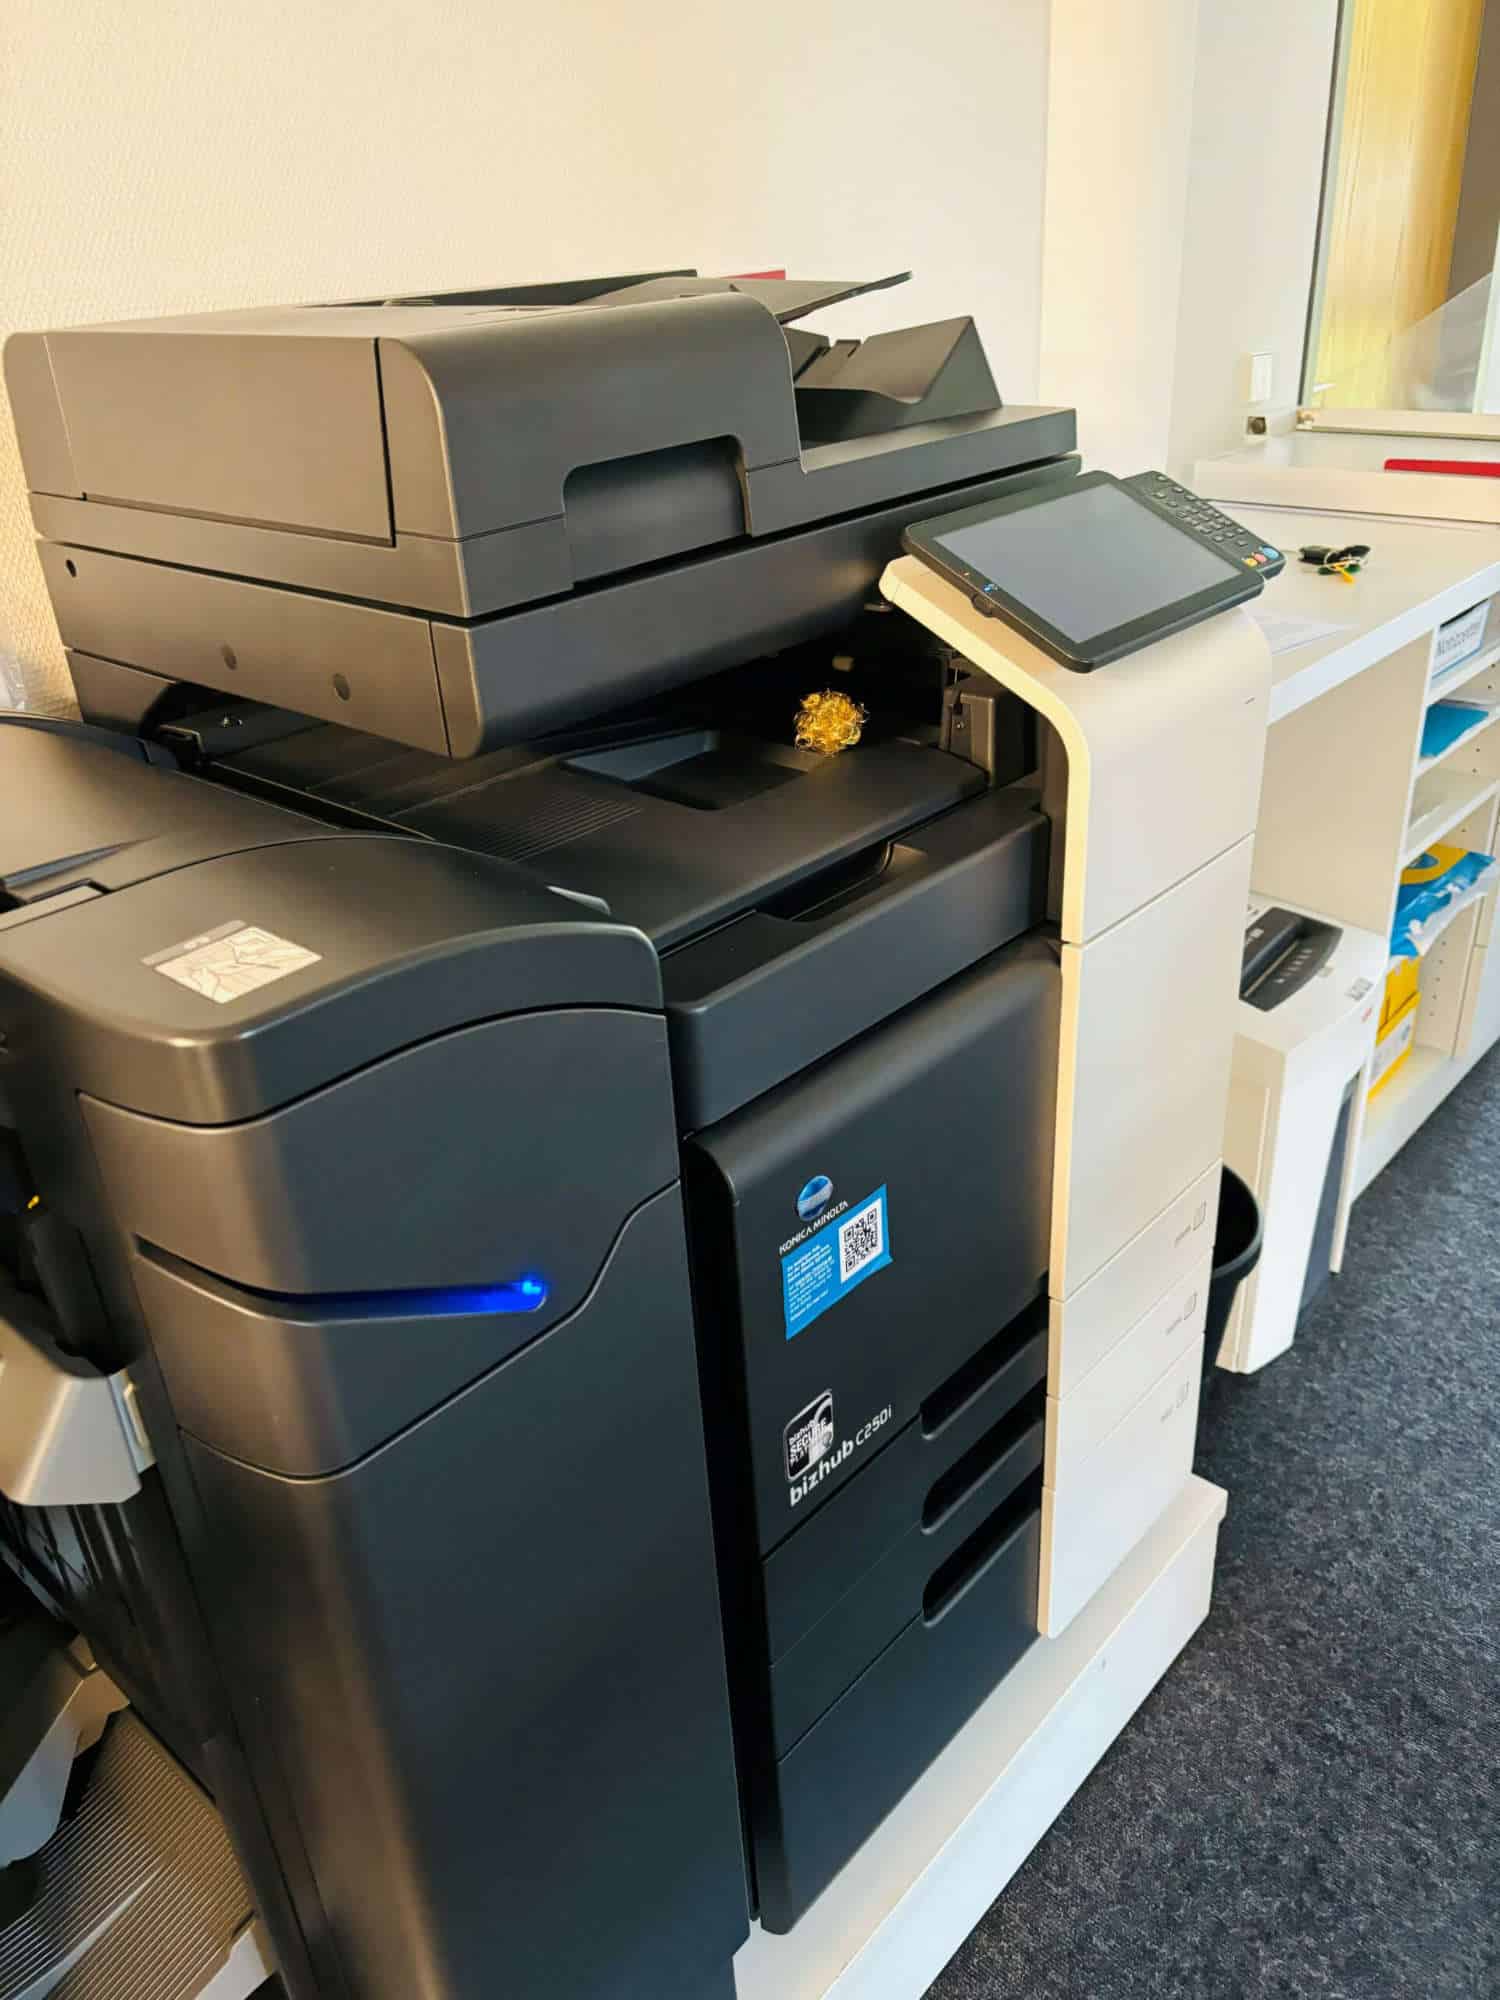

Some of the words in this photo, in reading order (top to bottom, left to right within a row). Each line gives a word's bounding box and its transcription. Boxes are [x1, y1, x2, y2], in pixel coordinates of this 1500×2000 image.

[779, 1226, 813, 1256] KONICA
[813, 1200, 848, 1231] MINOLTA
[790, 1439, 854, 1507] bizhub
[855, 1403, 892, 1446] C250i
